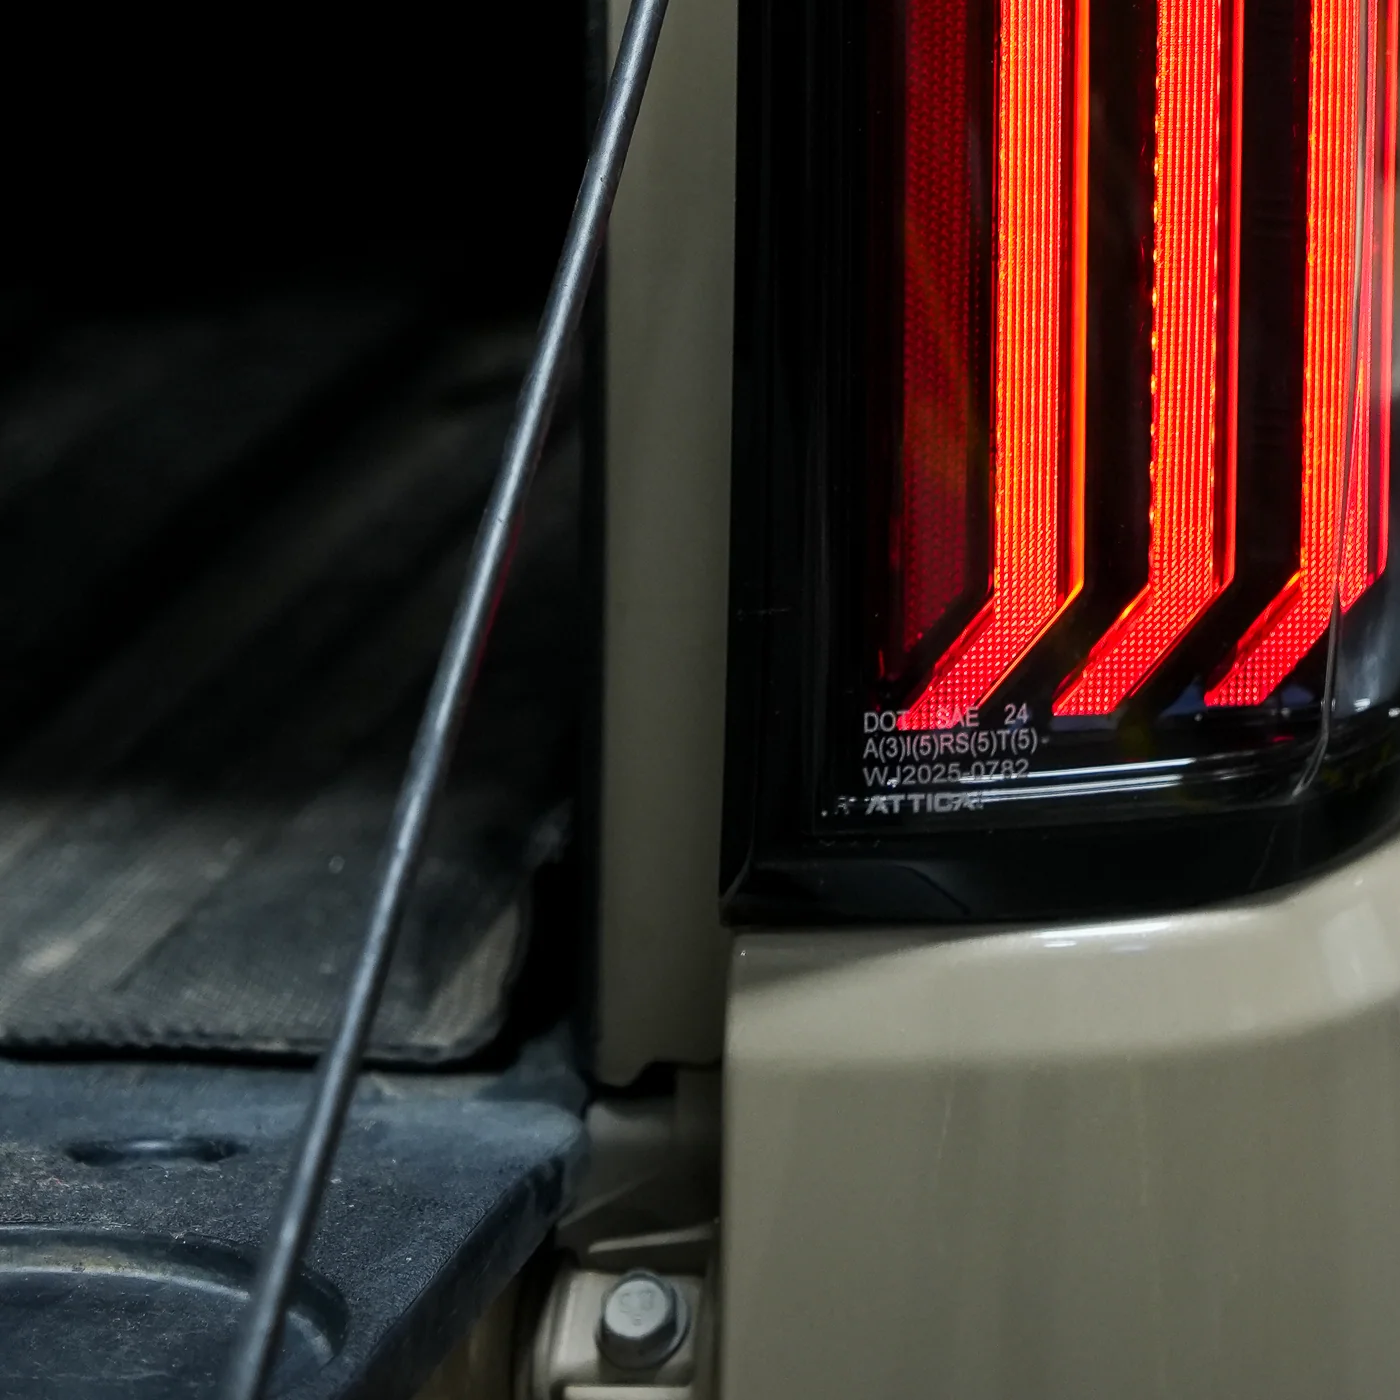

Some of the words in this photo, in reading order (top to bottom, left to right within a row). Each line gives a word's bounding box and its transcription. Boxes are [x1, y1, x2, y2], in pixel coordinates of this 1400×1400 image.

[864, 710, 909, 733] DOT
[937, 706, 980, 729] SAE
[1004, 702, 1029, 726] 24
